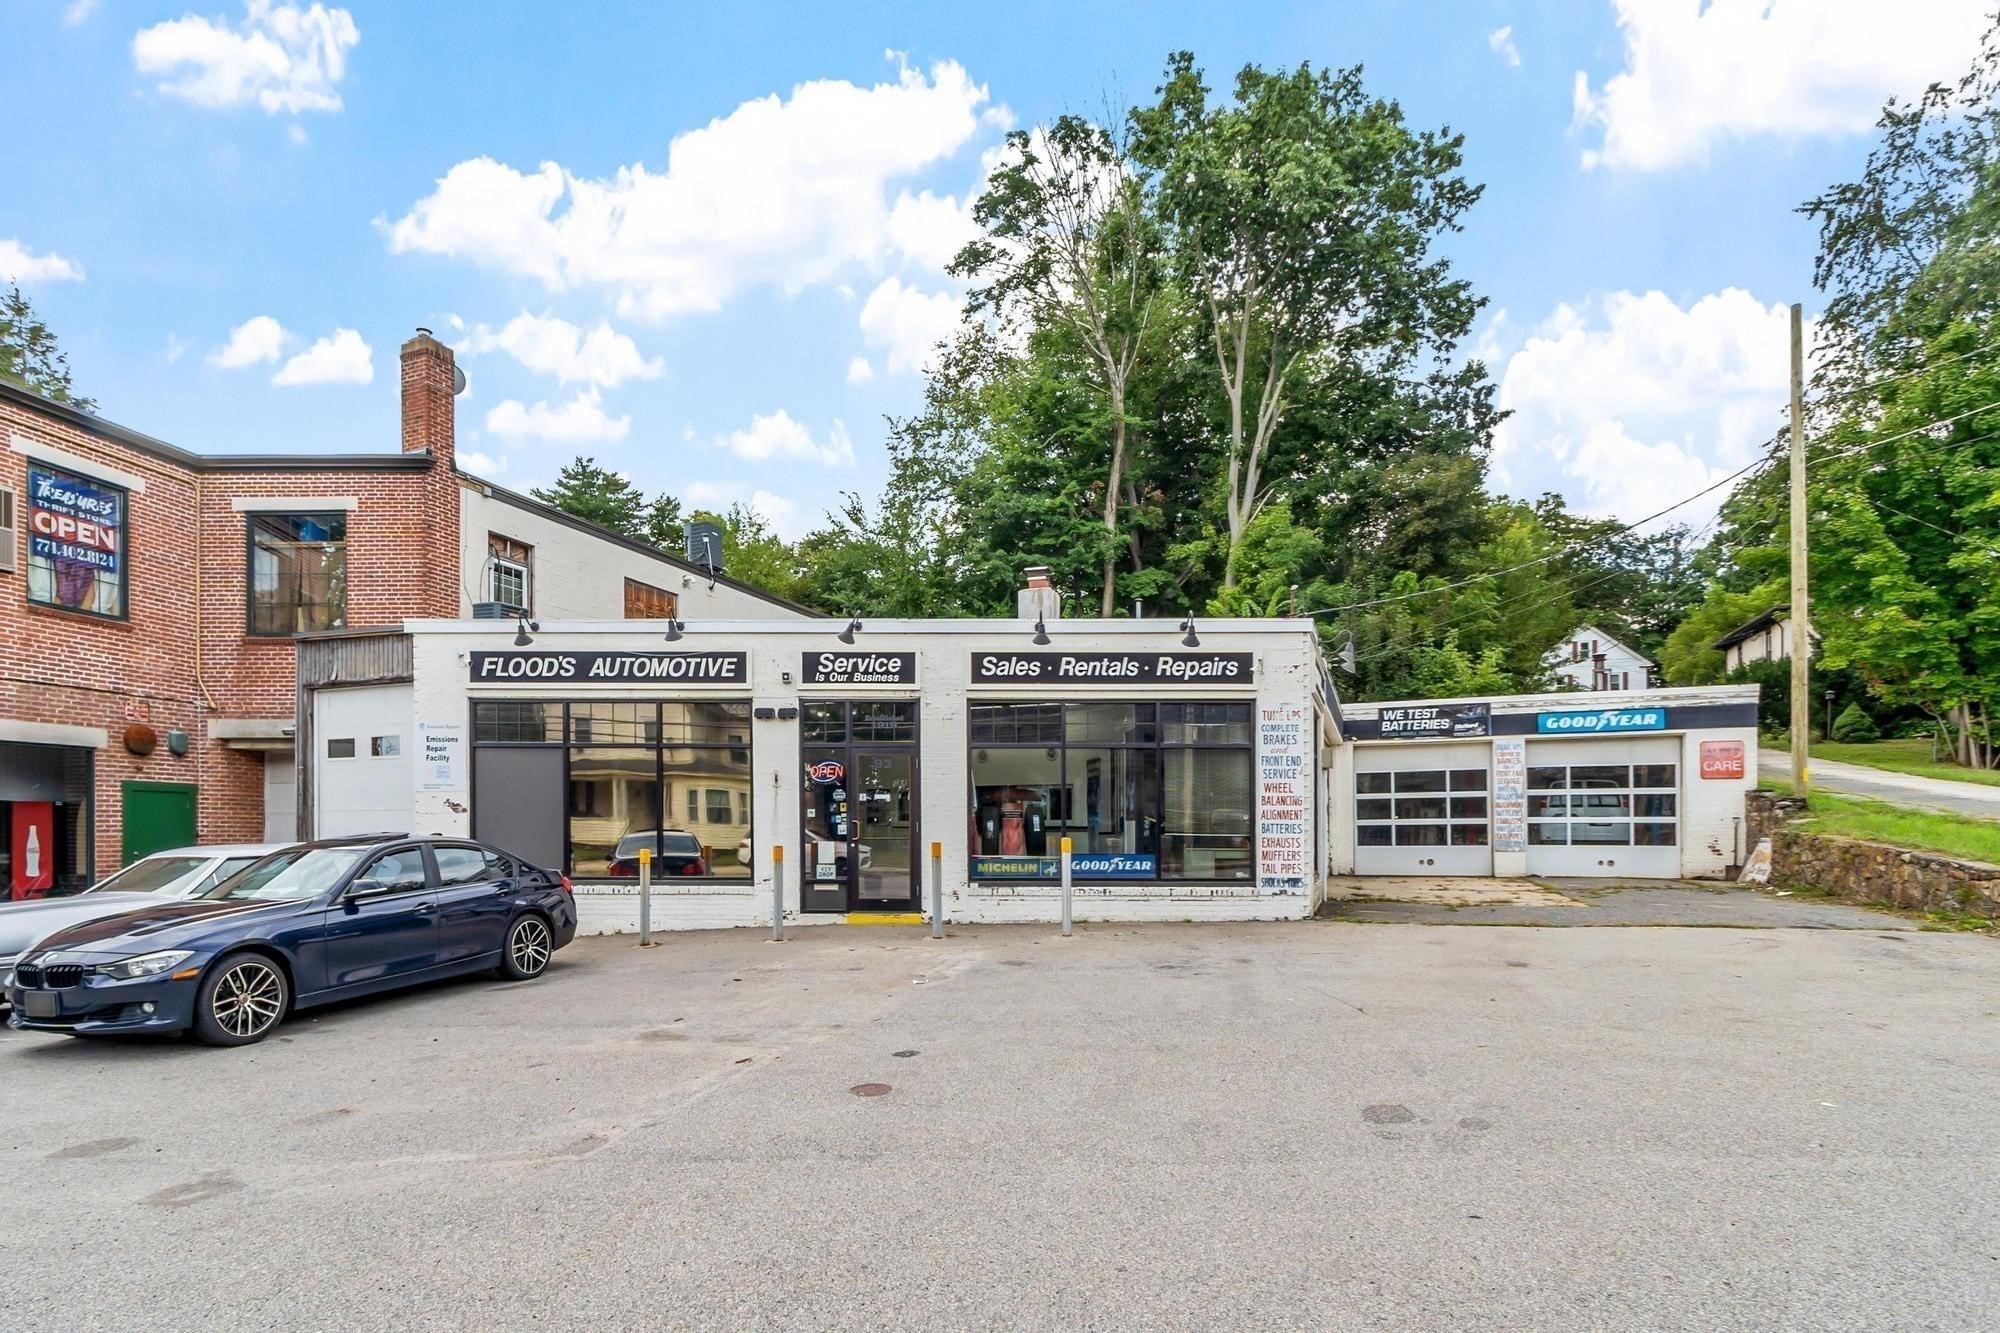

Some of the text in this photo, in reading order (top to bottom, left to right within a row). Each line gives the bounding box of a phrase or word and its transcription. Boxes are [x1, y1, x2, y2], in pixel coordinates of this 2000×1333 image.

[36, 480, 113, 515] TREASURES
[36, 499, 112, 526] THRIFT STORE
[34, 511, 114, 550] OPEN
[481, 655, 738, 677] FLOOD'S AUTOMOTIVE
[818, 653, 901, 673] Service
[980, 656, 1239, 681] Sales Rentals Repairs
[815, 672, 900, 682] Is Our Business
[1383, 708, 1440, 720] WE TEST
[1381, 719, 1451, 732] BATTERIES
[1546, 711, 1657, 730] GOODYEAR
[1261, 724, 1300, 733] COMPLETE
[1263, 734, 1297, 745] BRAKES
[426, 745, 447, 753] Repair
[1270, 746, 1289, 754] and
[425, 754, 450, 763] Facility
[1261, 755, 1302, 767] FRONT END
[1703, 760, 1741, 771] CARE
[810, 766, 844, 778] OPEN
[1262, 768, 1297, 779] SERVICE
[1263, 782, 1293, 794] WHEEL
[1261, 795, 1303, 806] BALANCING
[1261, 809, 1303, 821] ALIGNMENT
[1261, 823, 1303, 834] BATTERIES
[1261, 837, 1301, 848] EXHAUSTS
[1261, 850, 1302, 861] MUFFLERS
[977, 862, 1037, 873] MICHELIN
[1071, 858, 1151, 872] GOODYEAR
[1262, 863, 1302, 874] TAIL PIPES
